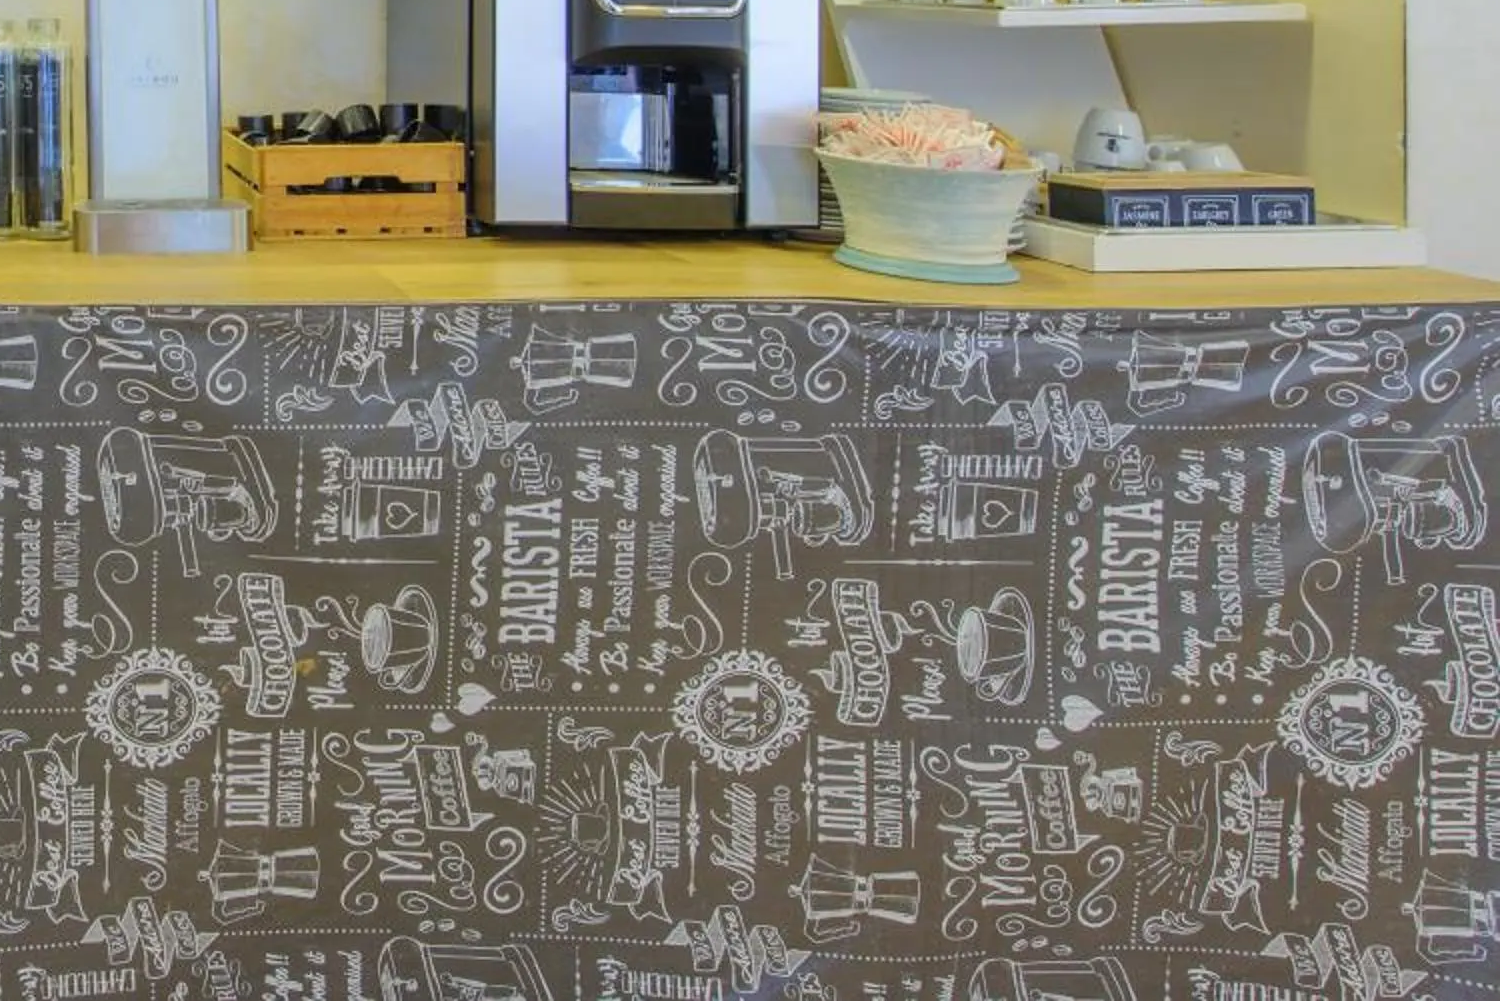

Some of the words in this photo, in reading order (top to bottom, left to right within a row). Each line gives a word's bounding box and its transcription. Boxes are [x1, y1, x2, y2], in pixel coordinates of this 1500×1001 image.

[19, 447, 43, 461] it
[319, 444, 350, 498] Away
[515, 442, 545, 496] RULES
[916, 441, 947, 497] Away
[1118, 445, 1147, 496] RULES
[1219, 448, 1244, 462] it
[1258, 447, 1299, 518] organised
[16, 470, 43, 510] about
[1217, 472, 1246, 513] about
[313, 501, 341, 545] Take
[909, 500, 937, 546] Take
[1170, 520, 1199, 581] FRESH
[14, 520, 41, 632] Passionate
[499, 501, 560, 646] BARISTA
[1097, 498, 1161, 653] BARISTA
[1211, 520, 1241, 643] Passionate
[1252, 521, 1284, 598] WORKSPACE
[242, 579, 291, 711] CHOCOLATE
[1265, 603, 1292, 637] your
[11, 643, 39, 677] Be
[508, 652, 536, 691] THE
[833, 582, 885, 718] CHOCOLATE
[1171, 628, 1213, 689] Always
[1209, 652, 1237, 687] Be
[1449, 589, 1494, 729] CHOCOLATE
[308, 651, 355, 710] Please!
[900, 657, 951, 721] Please!
[1113, 662, 1143, 707] THE
[279, 729, 305, 766] MADE
[874, 740, 902, 779] MADE
[38, 761, 66, 825] Coffee
[225, 729, 270, 828] LOCALLY
[277, 781, 303, 828] GROWN
[351, 729, 445, 882] MORNING
[428, 750, 463, 825] Coffee
[622, 761, 652, 822] Coffee
[816, 736, 865, 845] LOCALLY
[1430, 748, 1477, 857] LOCALLY
[176, 777, 209, 853] Affogato
[333, 801, 382, 846] Good
[766, 785, 801, 866] Affogato
[875, 797, 903, 848] GROWN
[954, 746, 1052, 910] MORNING
[1036, 769, 1071, 849] Coffee
[35, 839, 62, 890] Best
[618, 838, 646, 887] Best
[936, 824, 987, 871] Good
